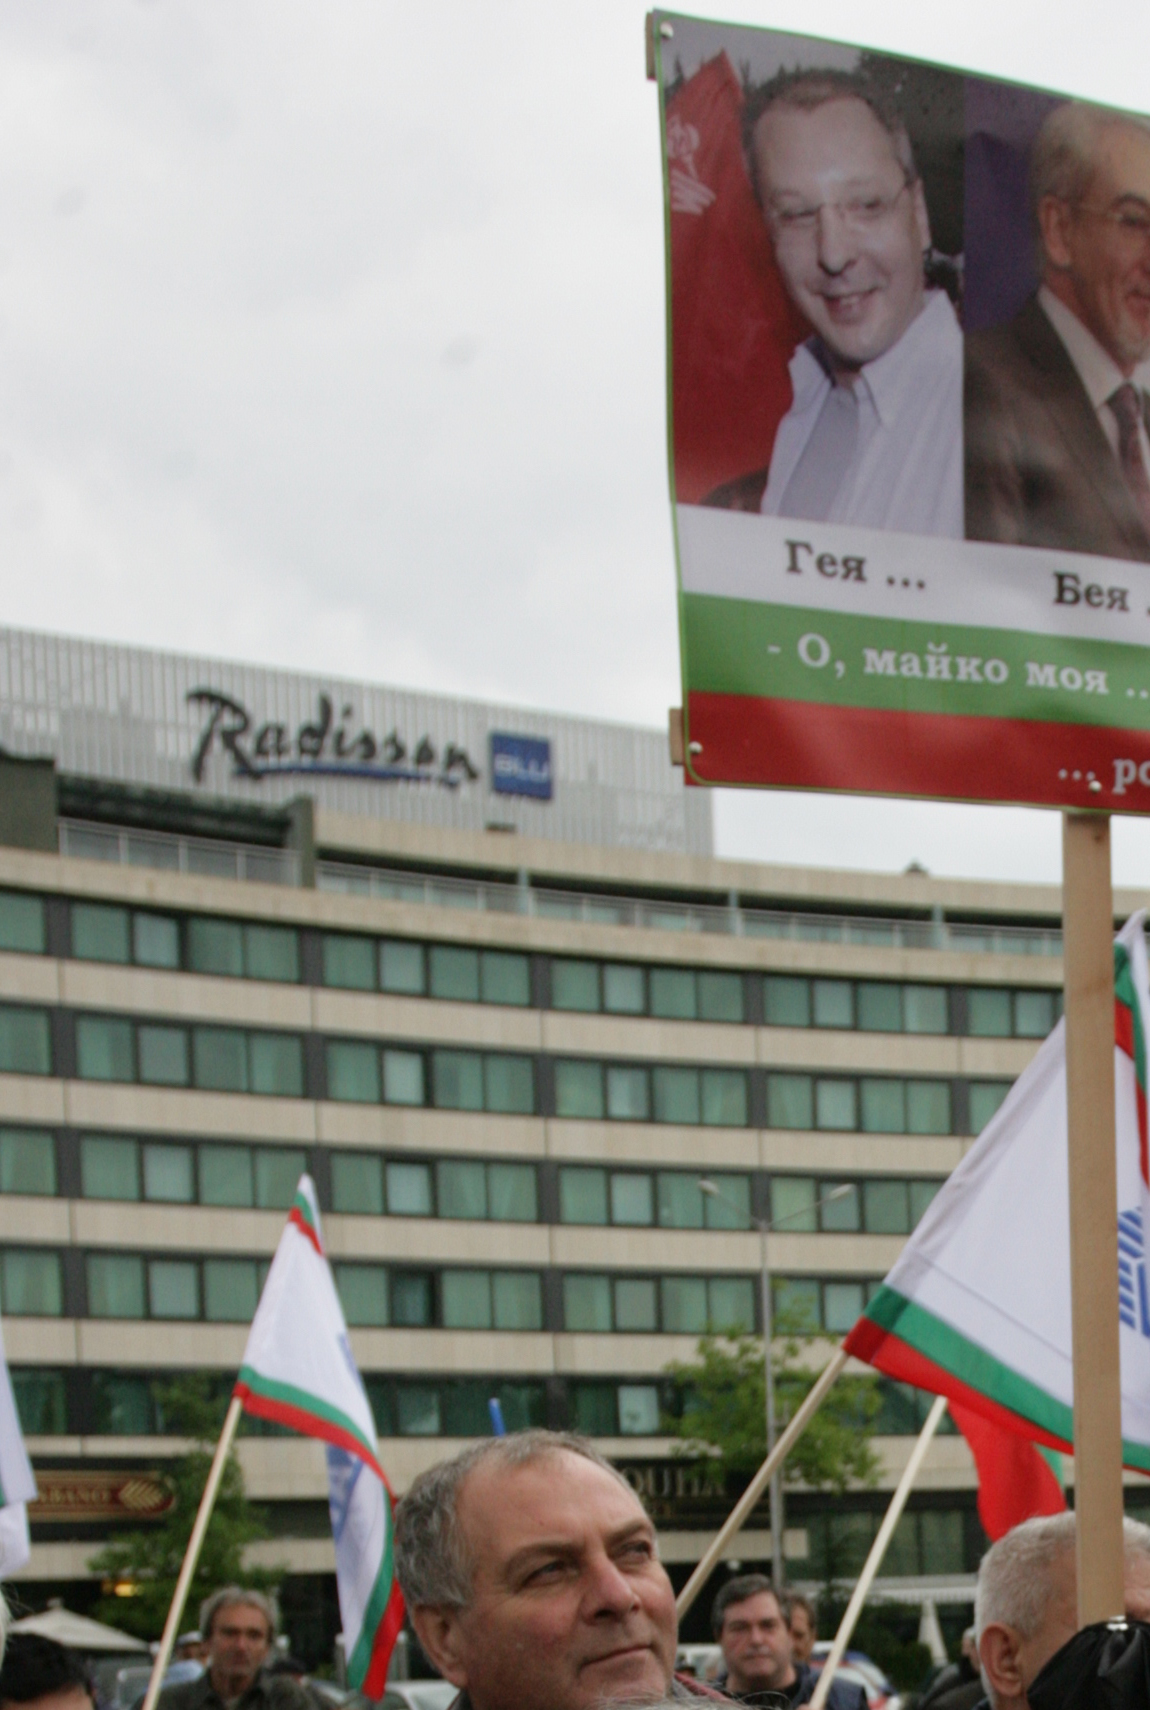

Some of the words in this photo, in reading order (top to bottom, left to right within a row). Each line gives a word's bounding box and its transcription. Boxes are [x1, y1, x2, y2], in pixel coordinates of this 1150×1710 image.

[785, 539, 868, 583] Гея
[1053, 571, 1130, 612] Бея
[797, 632, 846, 678] О,
[862, 641, 1010, 685] майко
[1025, 661, 1110, 695] моя
[186, 688, 478, 782] Radisson
[494, 753, 549, 783] BLU
